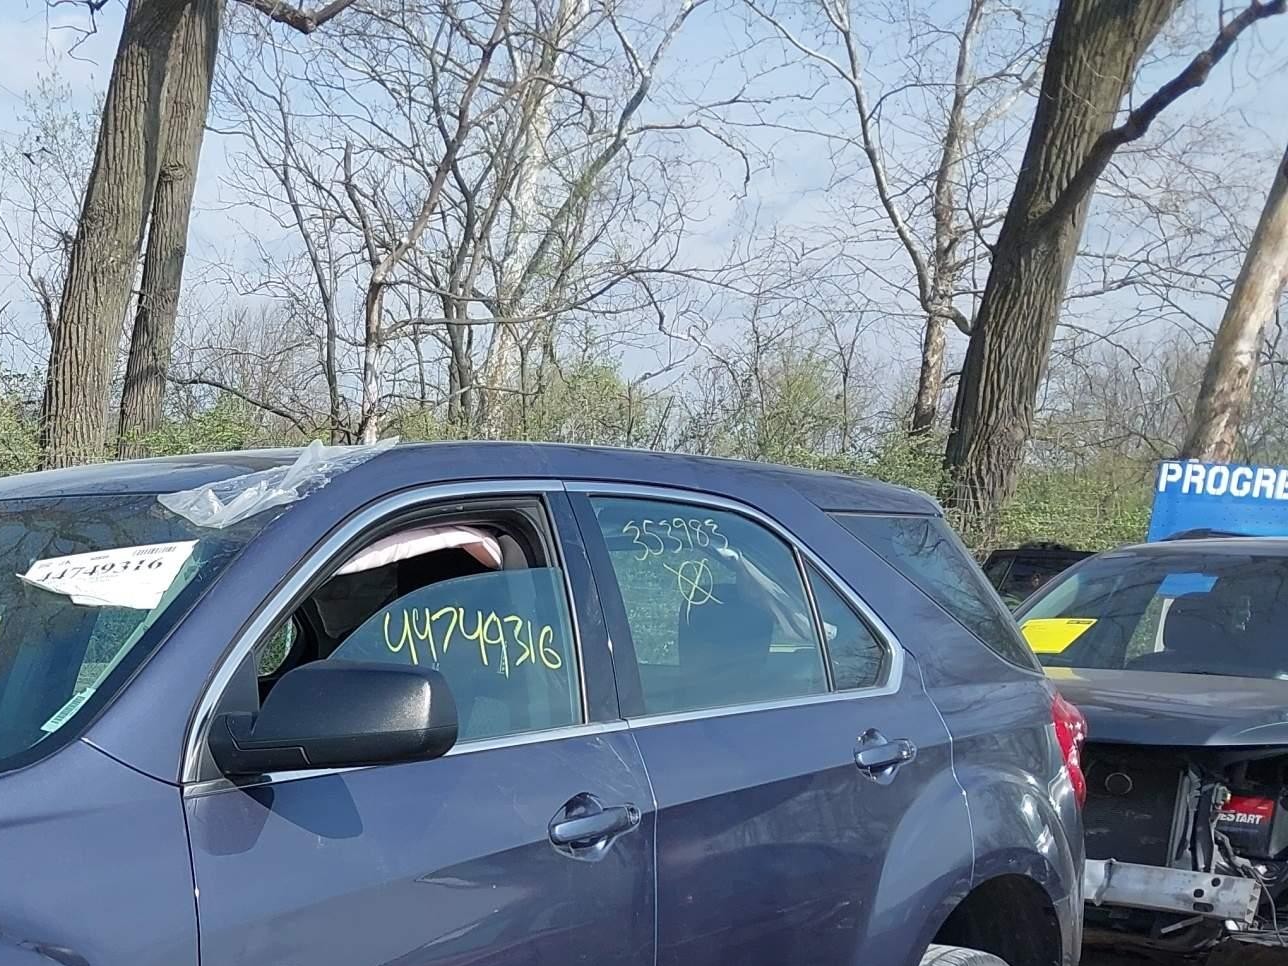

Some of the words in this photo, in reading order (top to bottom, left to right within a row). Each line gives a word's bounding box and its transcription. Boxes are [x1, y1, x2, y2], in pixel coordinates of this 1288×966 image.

[1158, 462, 1288, 500] PROGRE
[622, 517, 728, 561] 353983
[384, 606, 562, 680] 44749316
